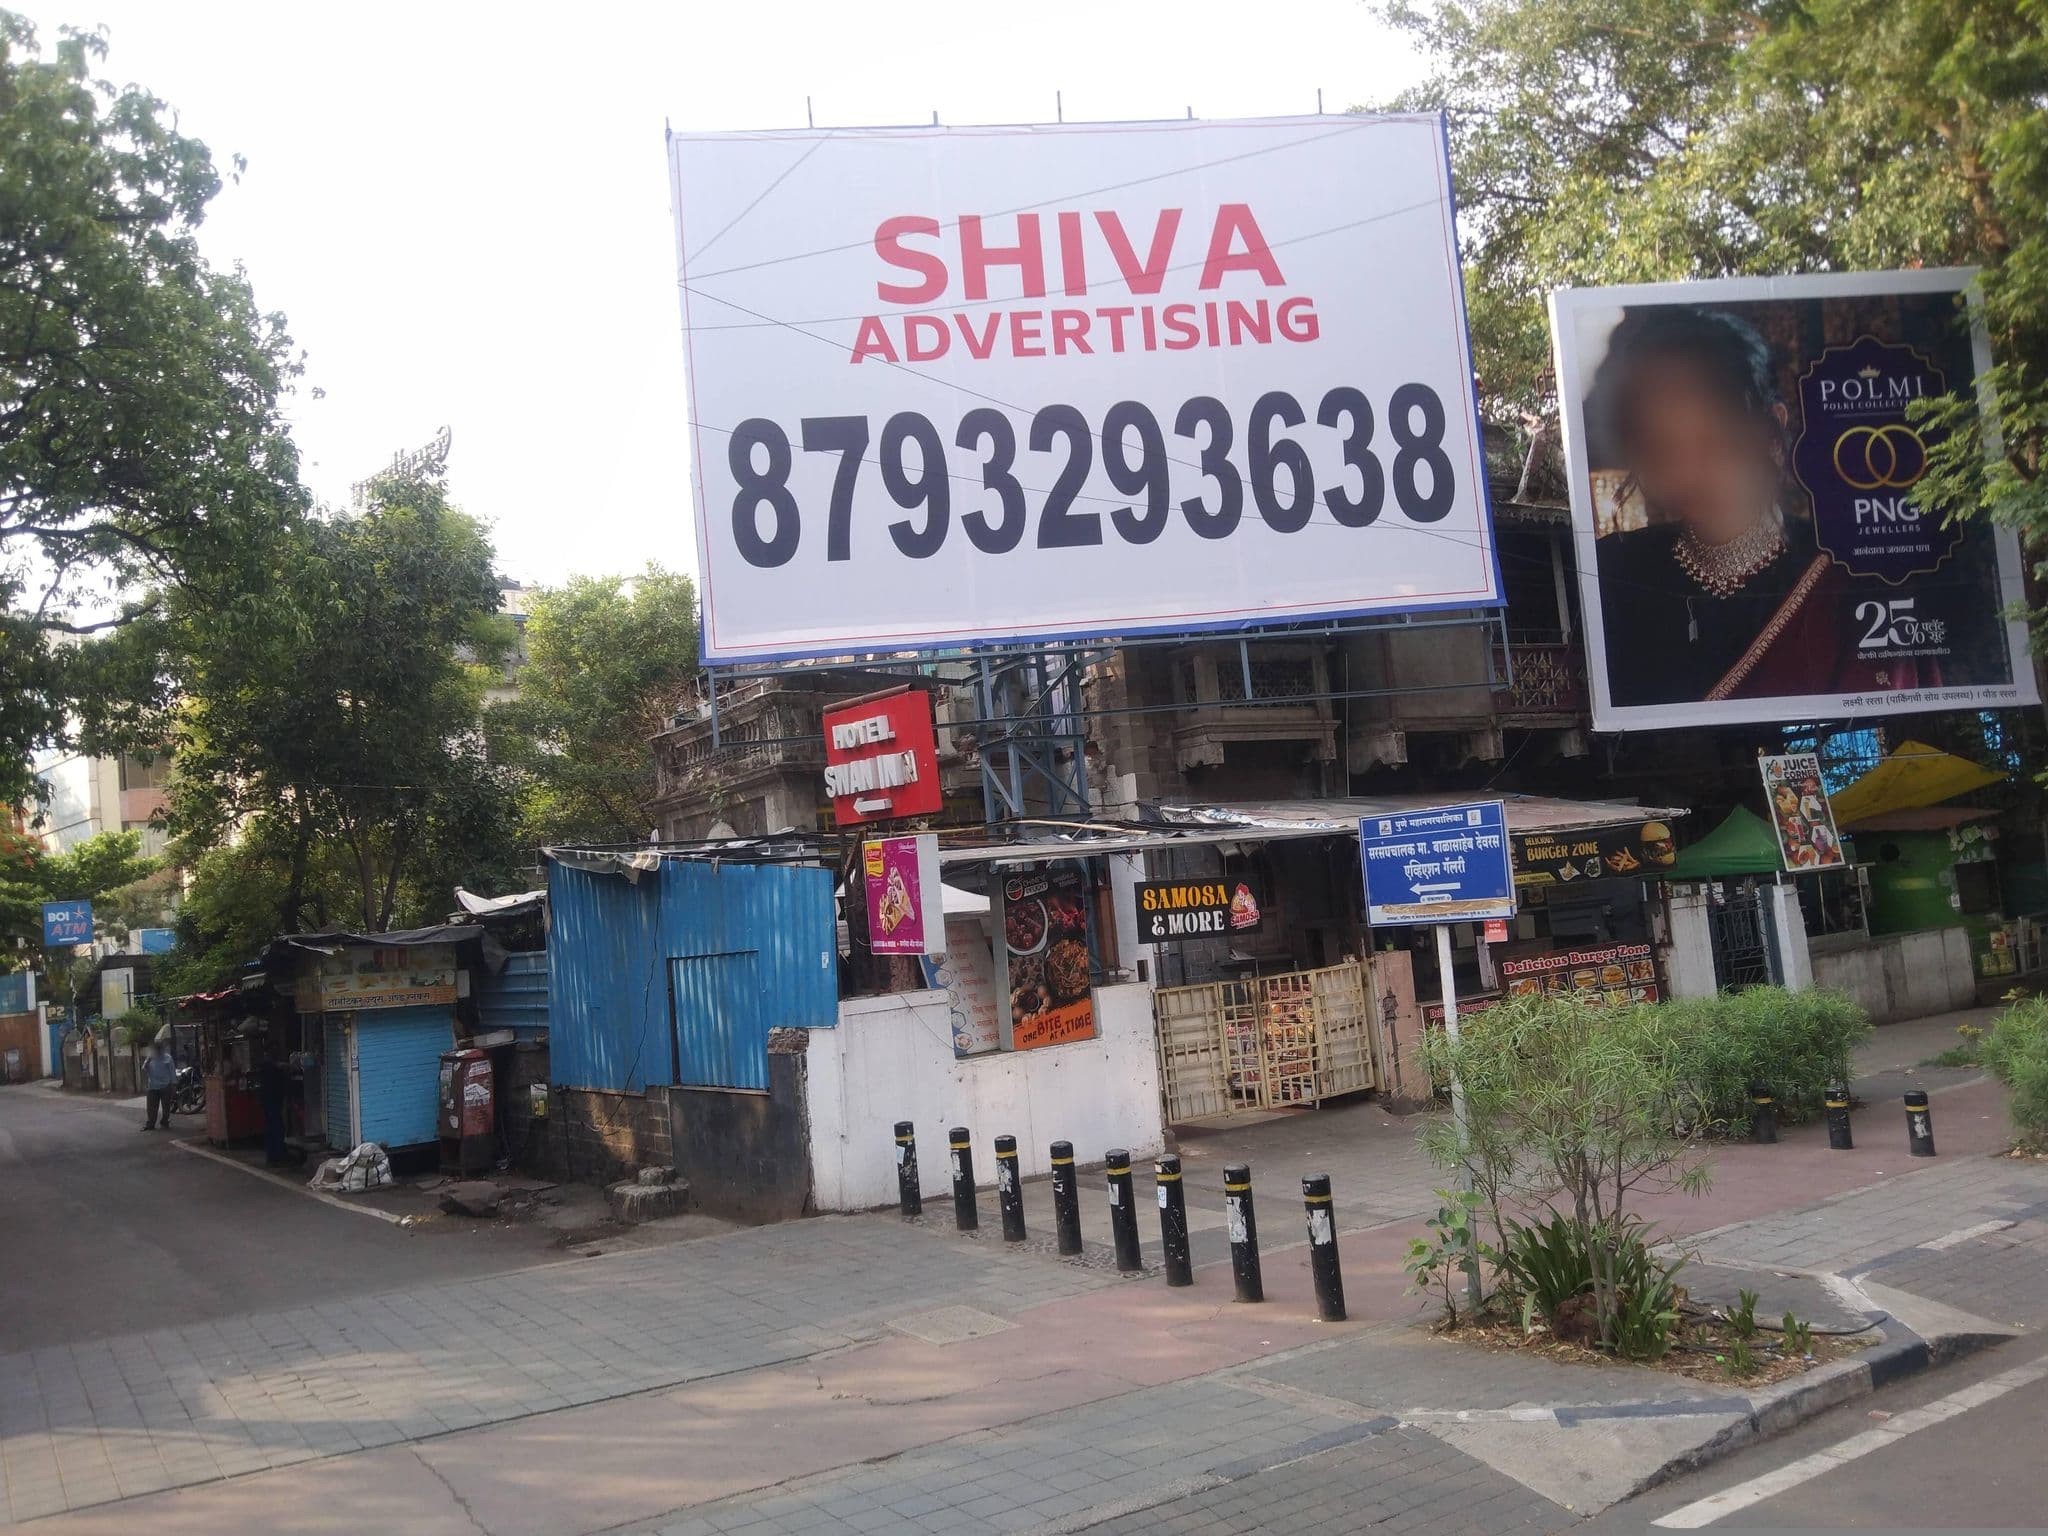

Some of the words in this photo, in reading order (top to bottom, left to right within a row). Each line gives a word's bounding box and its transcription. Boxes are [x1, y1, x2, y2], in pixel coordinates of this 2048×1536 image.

[874, 203, 1287, 305] SHIVA
[849, 297, 1320, 364] ADVERTISING
[1820, 375, 1924, 402] POLMI
[728, 382, 1456, 569] 8793293638
[1854, 497, 1920, 524] PNG
[1858, 524, 1921, 535] JEWELLERS
[1855, 597, 1925, 649] 25%
[831, 714, 896, 750] HOTEL
[824, 756, 877, 798] SWAN
[1782, 758, 1818, 771] JUICE
[1783, 769, 1819, 780] CORNER
[1395, 817, 1408, 832] पुणे
[1409, 812, 1464, 828] महानगरपालिका
[1432, 833, 1474, 854] बाळासाहेब
[1475, 831, 1501, 851] देवरस
[1524, 836, 1555, 847] DELICIOUS
[1527, 844, 1569, 862] BURGER
[1571, 841, 1600, 857] ZONE
[1403, 858, 1441, 881] एव्हिएशन
[1442, 856, 1466, 875] गॅलरी
[1143, 884, 1229, 910] SAMOSA
[47, 911, 70, 923] BOI
[51, 922, 87, 936] ATM
[1151, 914, 1166, 937] &
[1167, 910, 1226, 935] MORE
[1503, 955, 1568, 975] Delicious
[1569, 949, 1617, 965] Burger
[1617, 944, 1651, 956] Zone
[47, 1006, 65, 1018] P2
[1037, 1015, 1062, 1036] BITE
[1065, 1012, 1092, 1033] TIME
